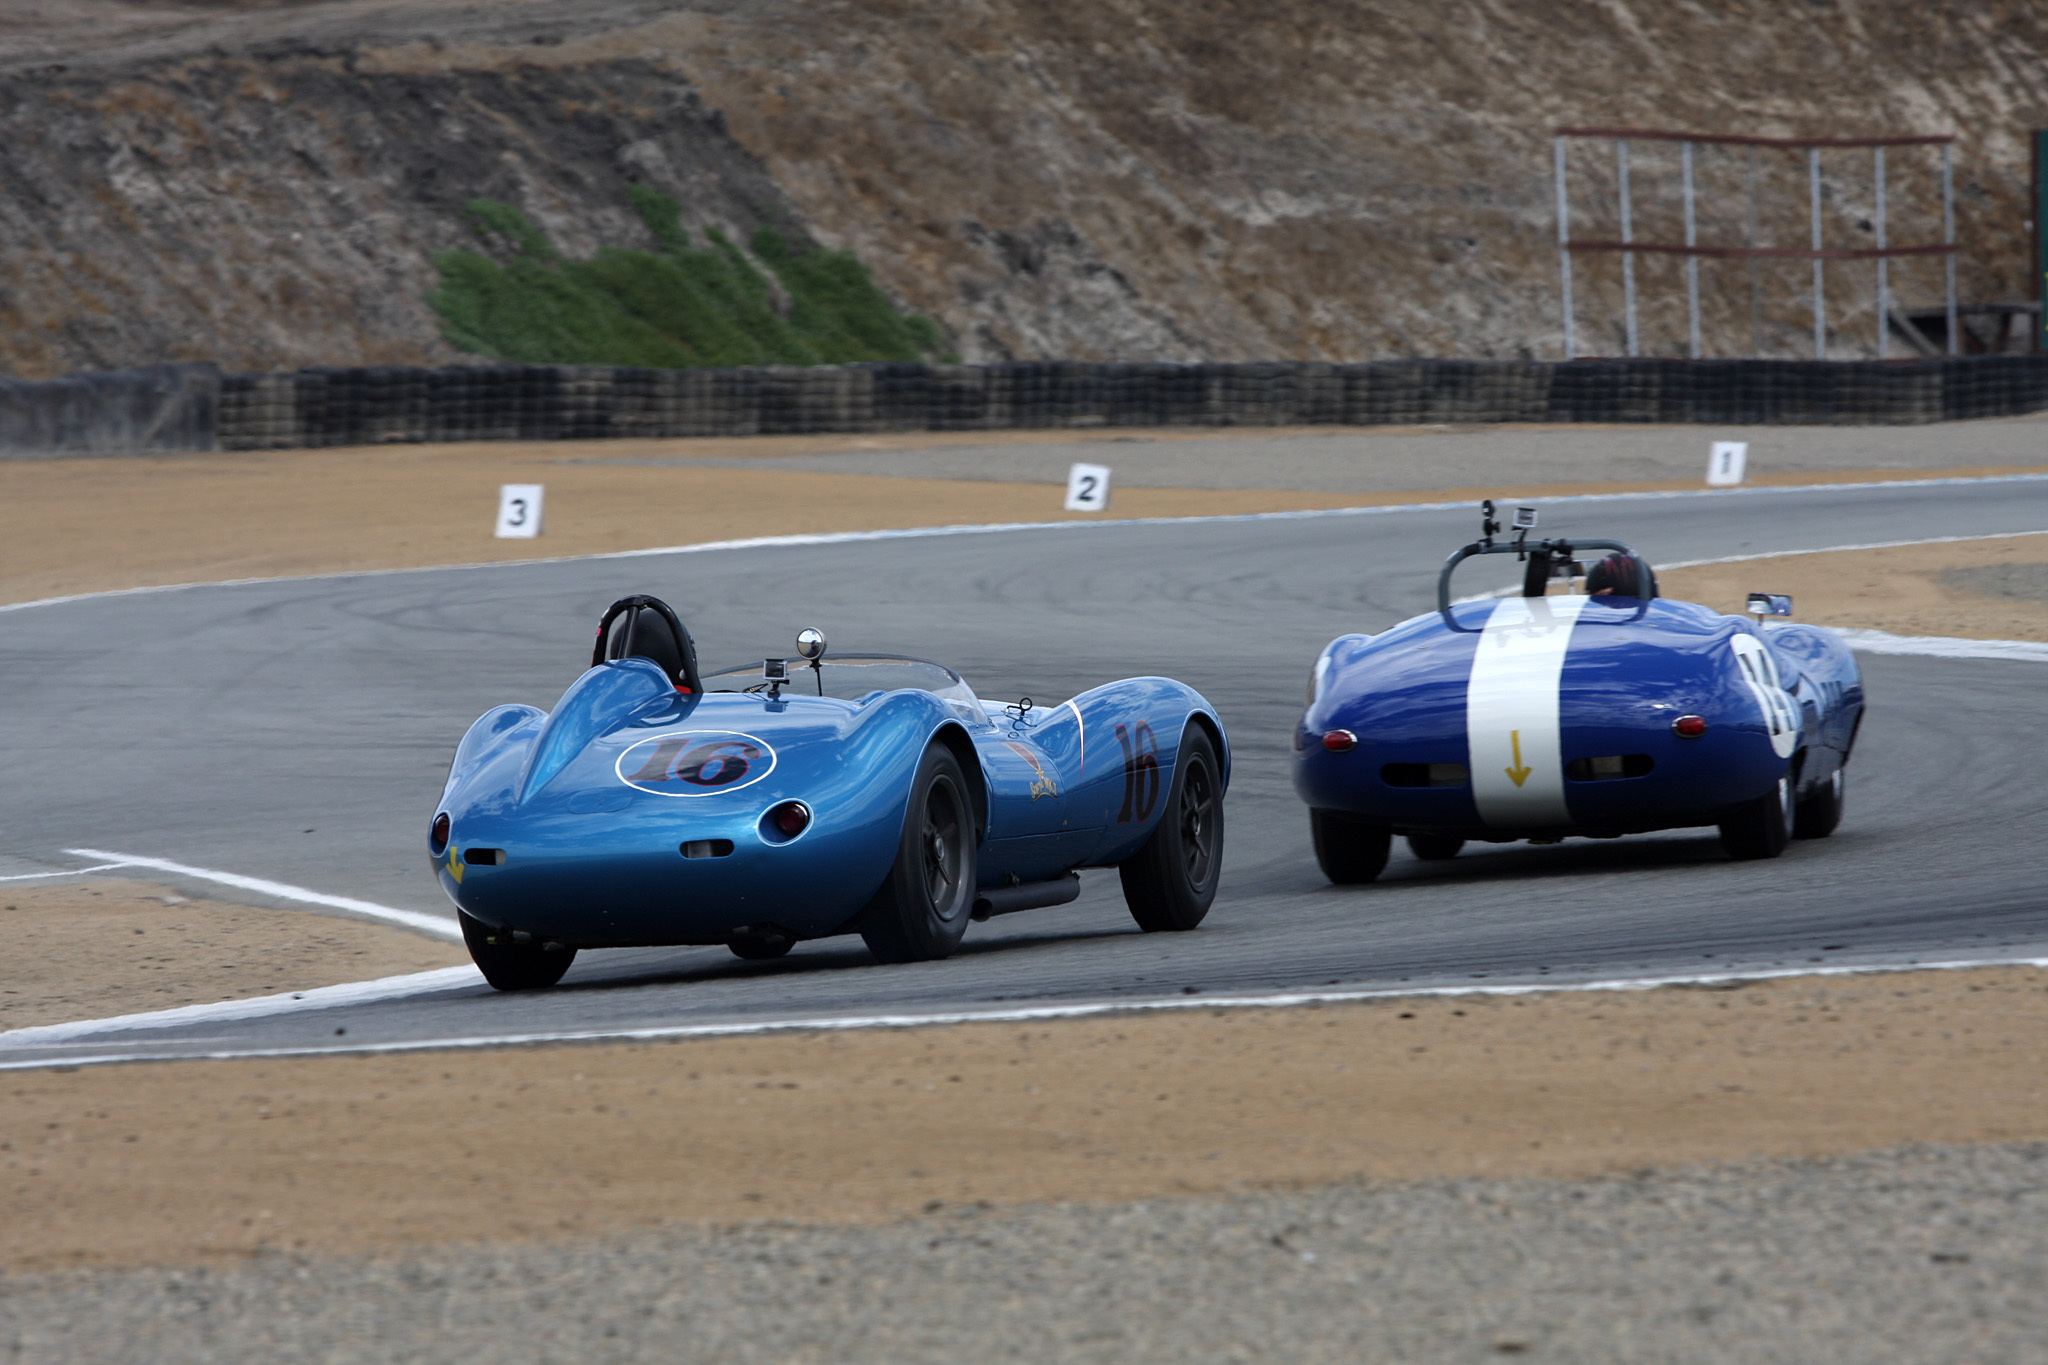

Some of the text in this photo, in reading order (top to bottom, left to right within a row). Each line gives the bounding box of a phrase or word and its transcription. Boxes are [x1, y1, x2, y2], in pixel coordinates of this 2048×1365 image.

[1720, 451, 1732, 475] 1
[1077, 475, 1097, 502] 2
[508, 498, 528, 527] 3
[627, 738, 761, 786] 16
[1114, 720, 1160, 824] 16
